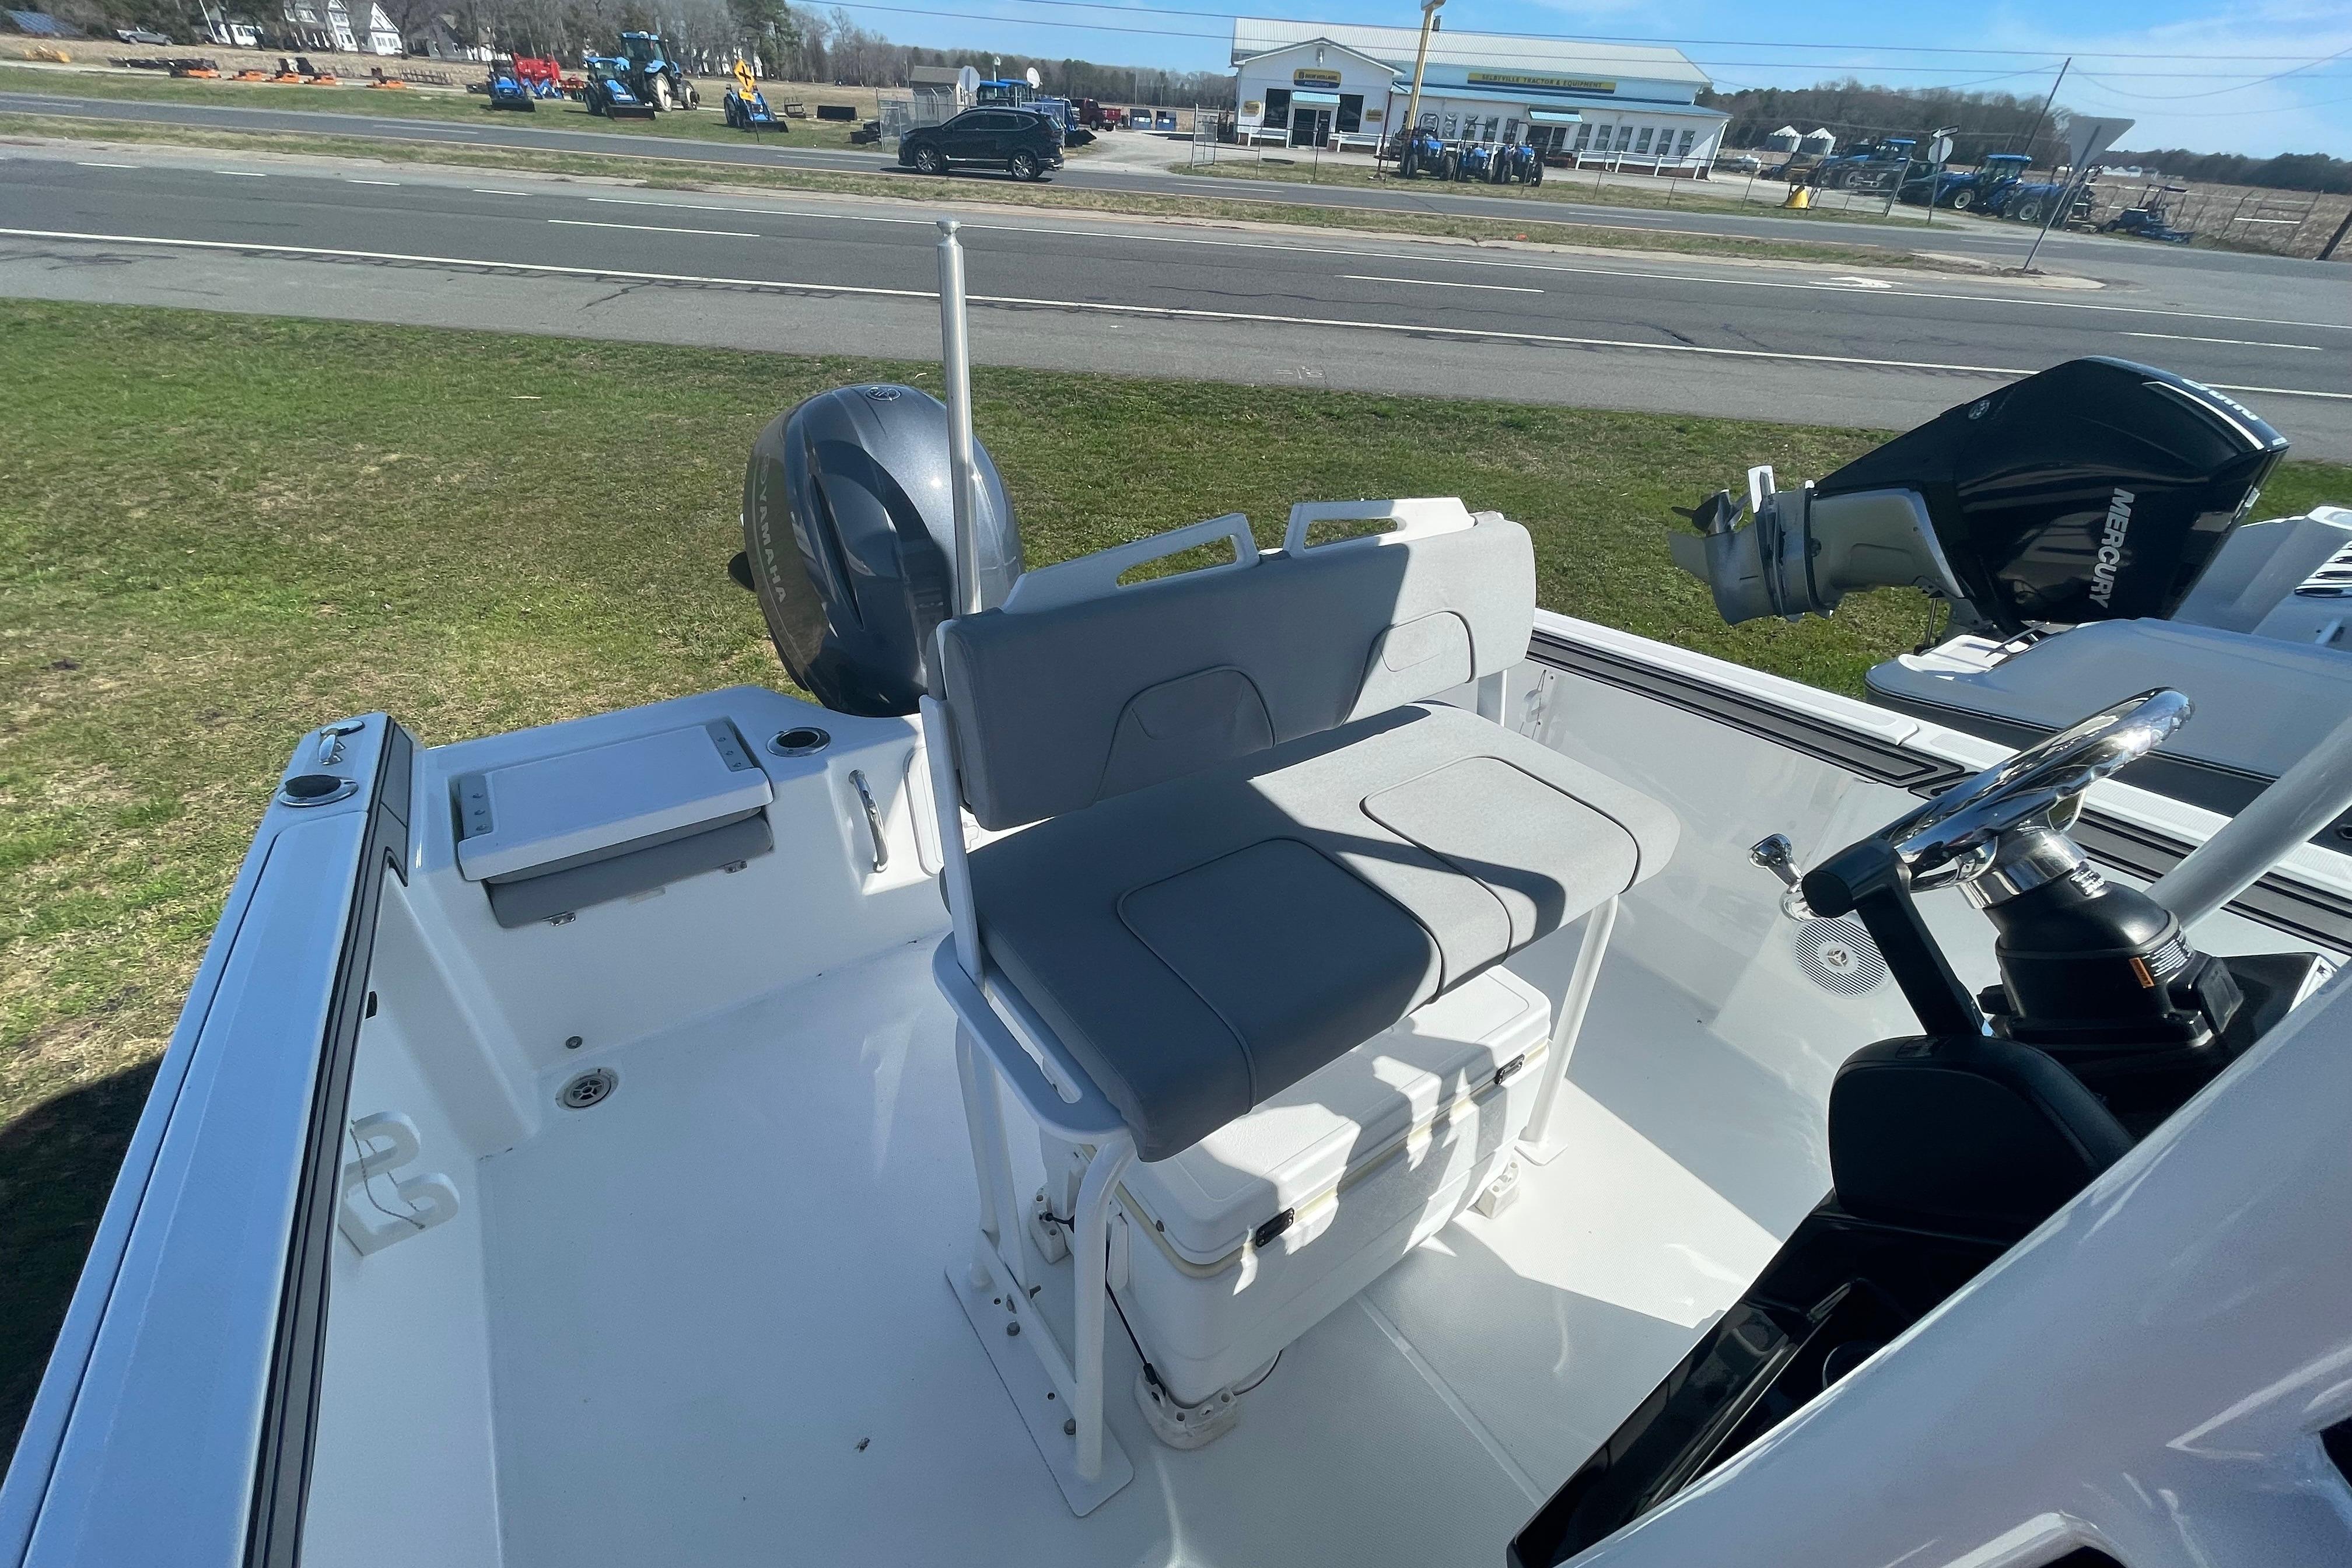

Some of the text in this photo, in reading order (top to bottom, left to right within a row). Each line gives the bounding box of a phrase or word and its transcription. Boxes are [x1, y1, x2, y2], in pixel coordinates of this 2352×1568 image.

[1524, 76, 1553, 85] TRACTOR
[1563, 79, 1602, 88] EQUIPMENT
[760, 485, 786, 603] YAMAHA
[2089, 488, 2135, 608] MERCURY
